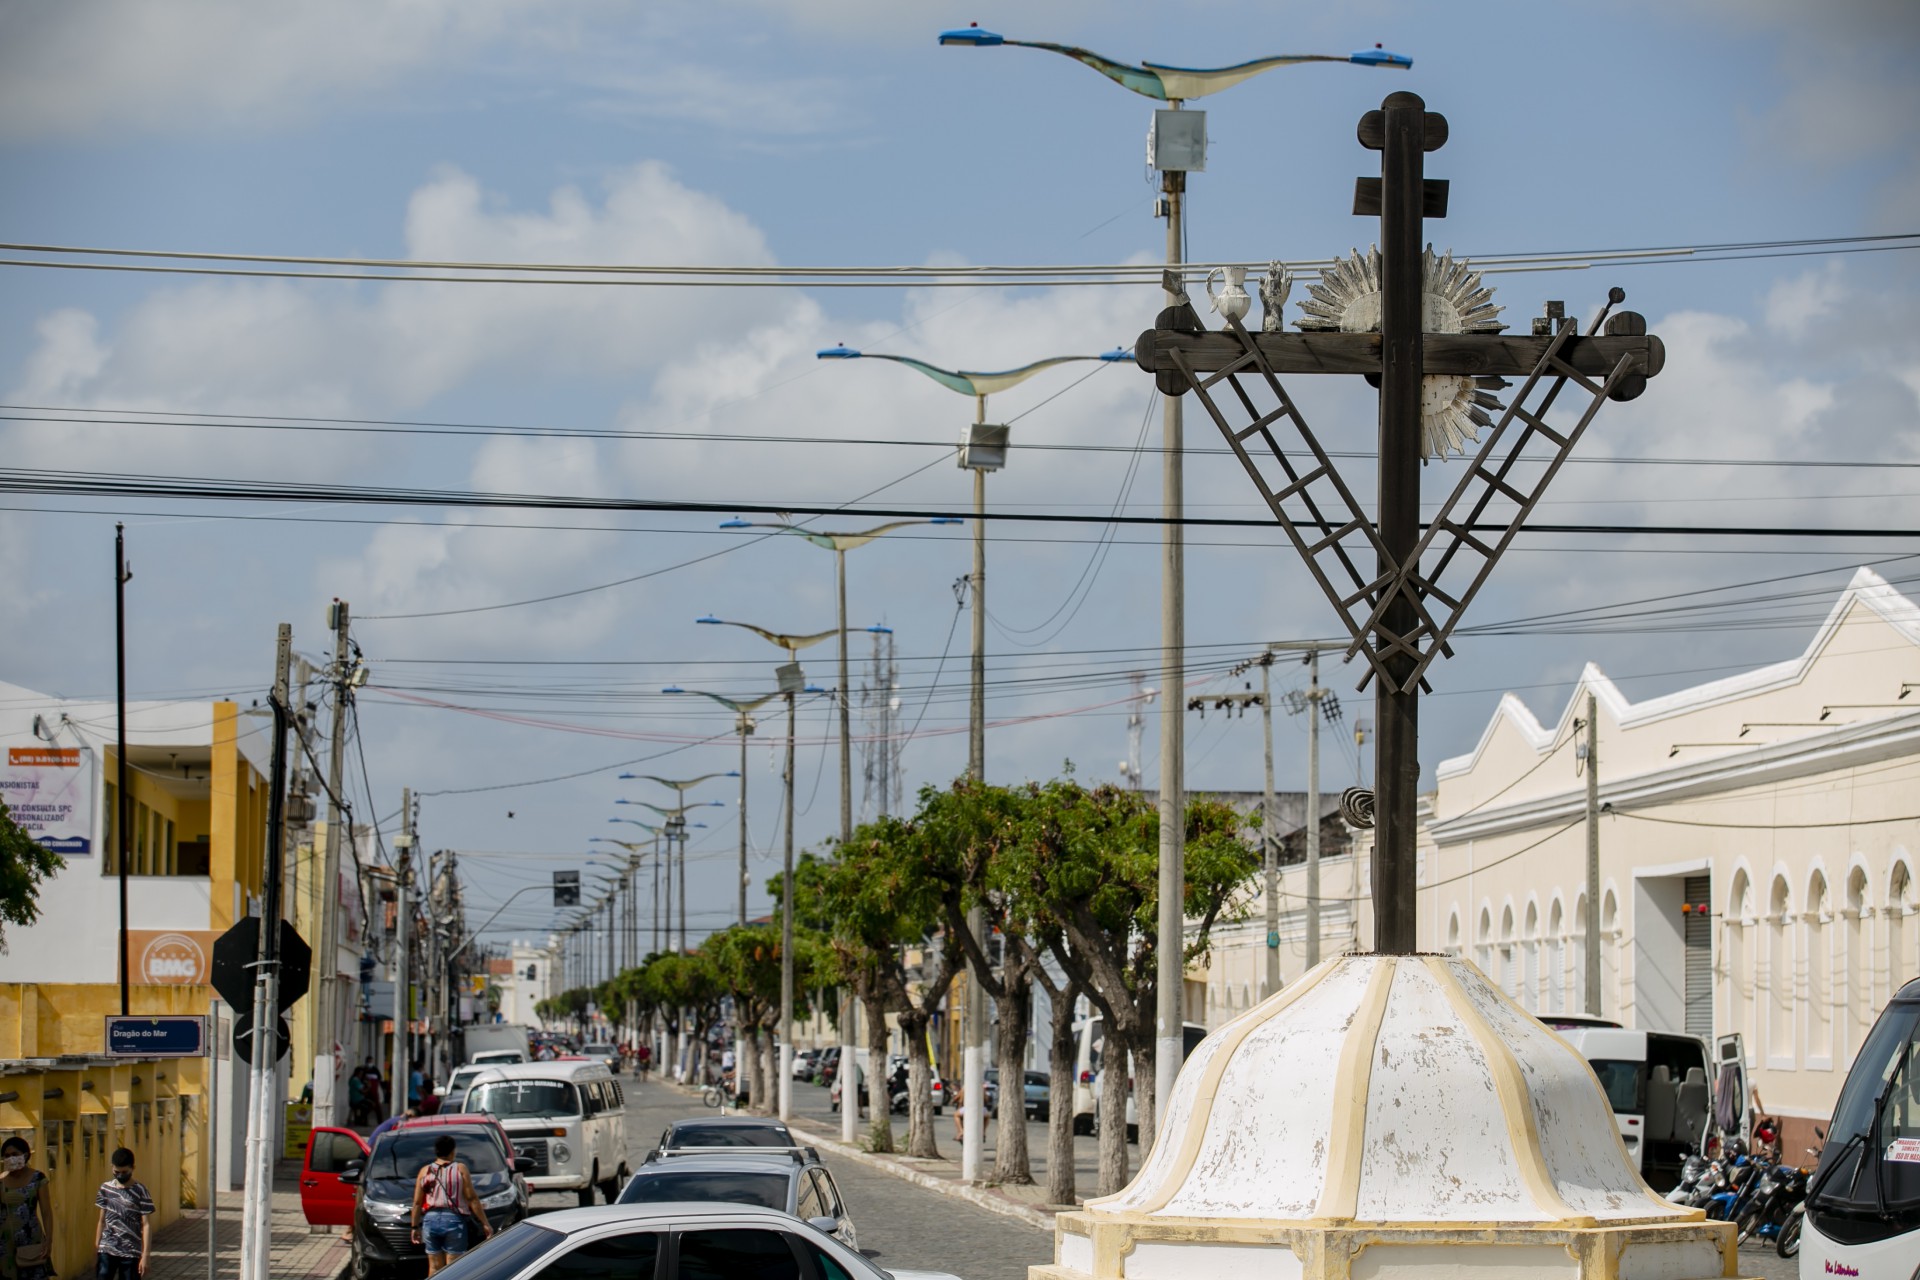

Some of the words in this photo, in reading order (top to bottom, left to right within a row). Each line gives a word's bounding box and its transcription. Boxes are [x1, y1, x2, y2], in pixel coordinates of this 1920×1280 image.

[21, 804, 56, 812] CONSULTA
[150, 958, 197, 977] BMG
[113, 1030, 141, 1039] Dragão
